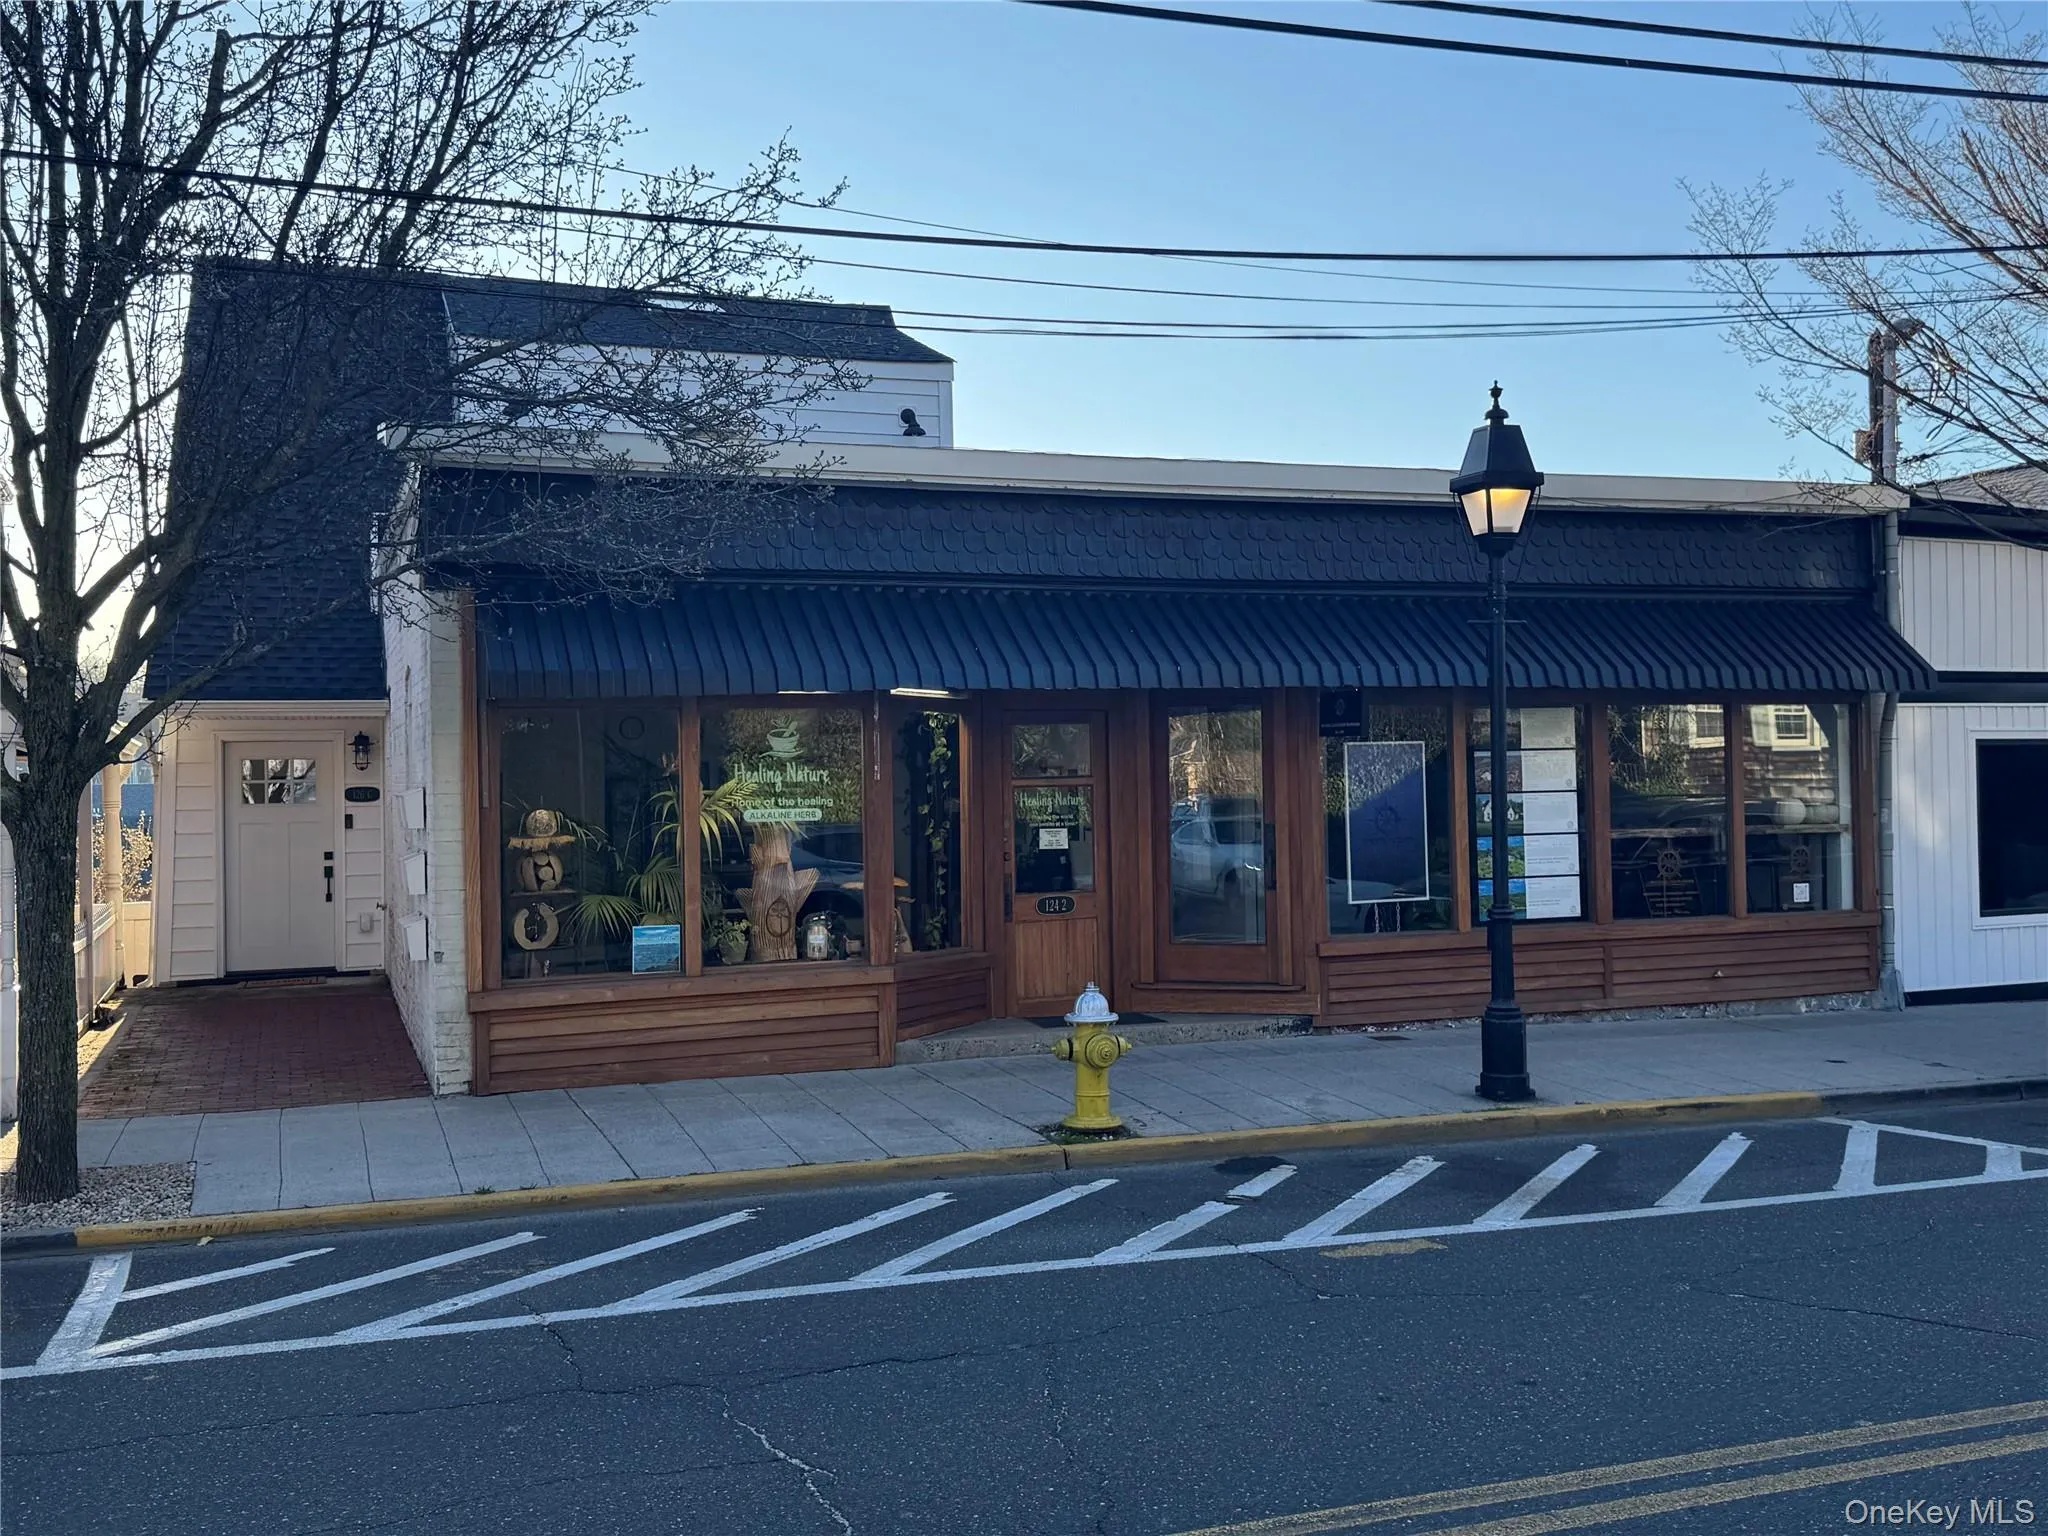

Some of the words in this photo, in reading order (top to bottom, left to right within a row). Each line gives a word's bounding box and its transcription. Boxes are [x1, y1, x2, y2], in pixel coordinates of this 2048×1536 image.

[734, 761, 782, 792] Healing
[786, 761, 831, 785] Nature
[731, 798, 761, 807] Home
[764, 797, 775, 807] of
[778, 797, 795, 806] the
[798, 796, 833, 807] healing
[1019, 791, 1053, 813] Healing
[749, 811, 792, 820] ALKALINE
[794, 810, 817, 819] HERB
[1045, 899, 1059, 912] 124
[1061, 898, 1067, 911] 2
